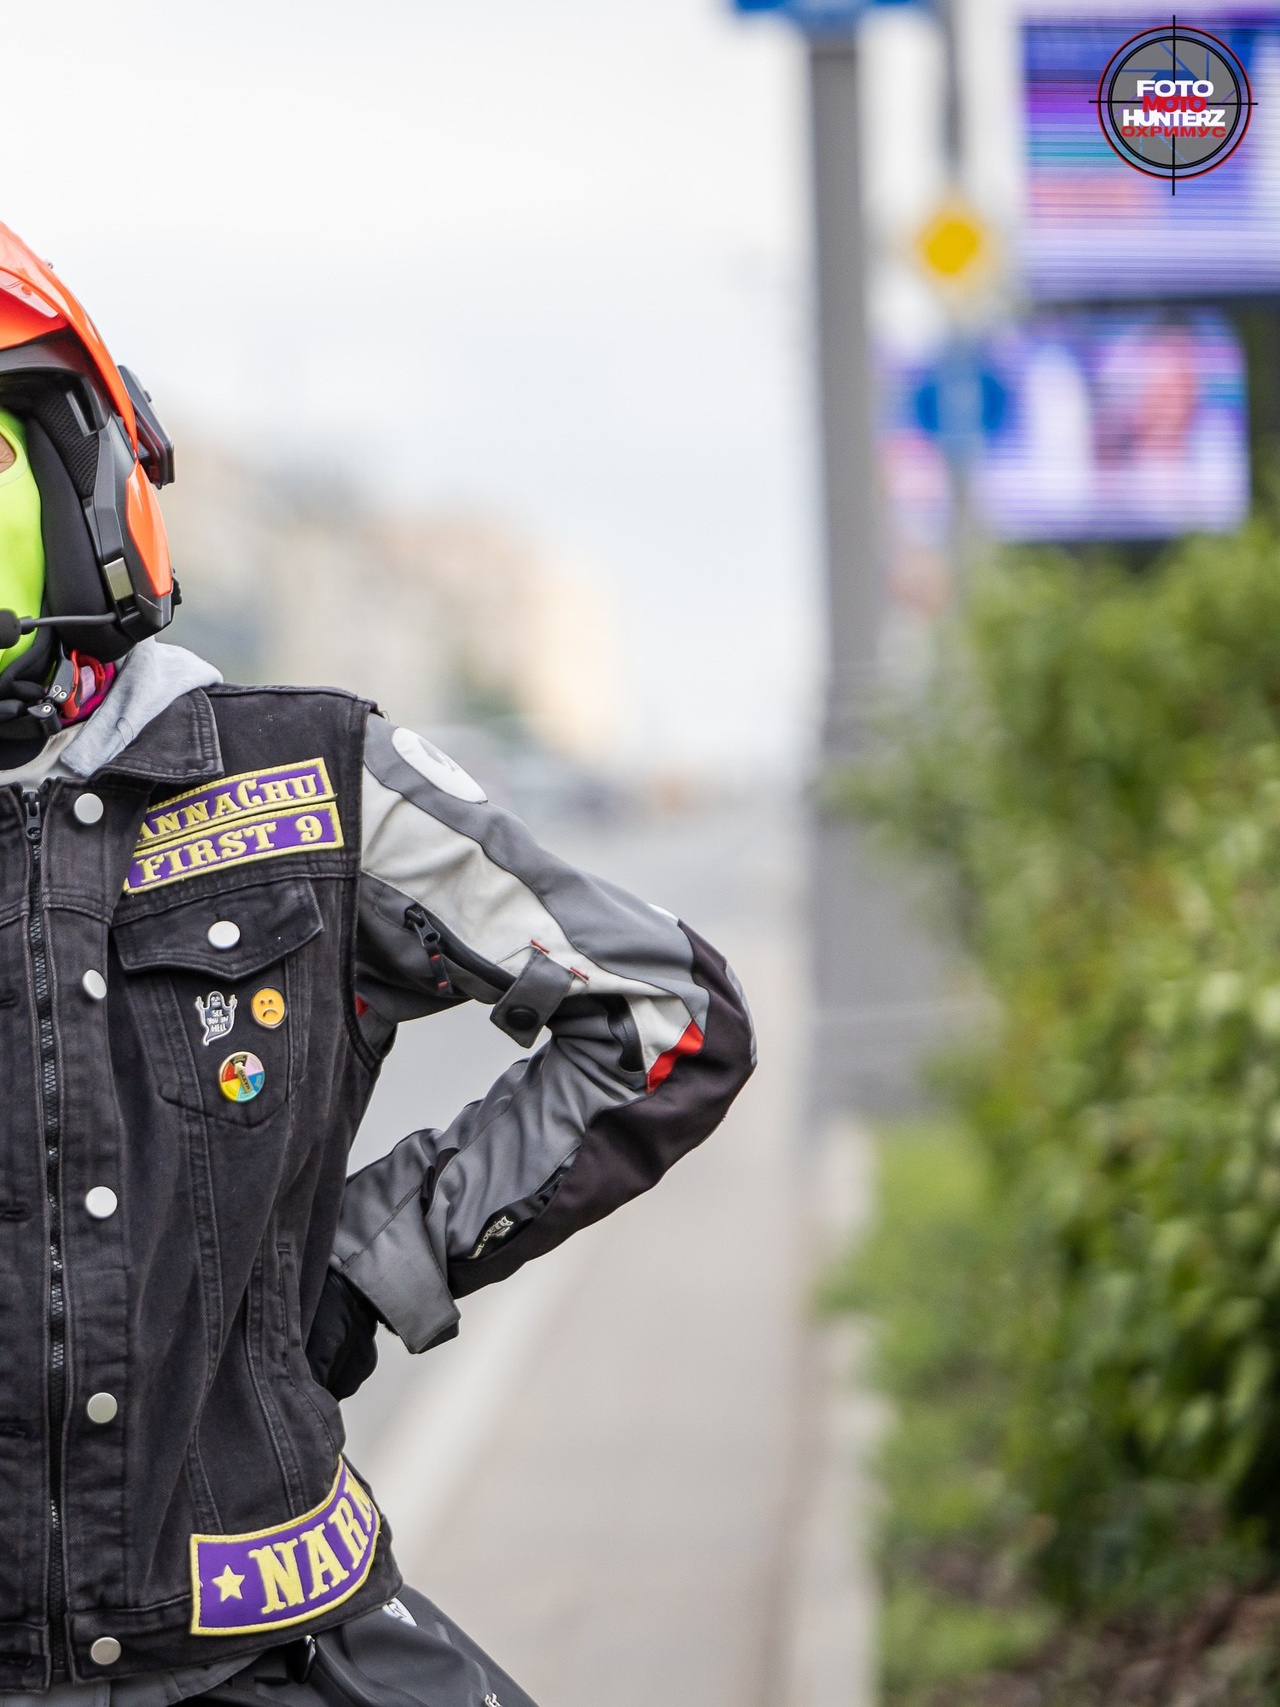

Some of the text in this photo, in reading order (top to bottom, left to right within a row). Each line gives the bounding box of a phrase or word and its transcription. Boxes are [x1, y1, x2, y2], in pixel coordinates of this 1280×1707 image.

[136, 815, 323, 883] FIRST 9
[211, 1024, 227, 1032] HELL
